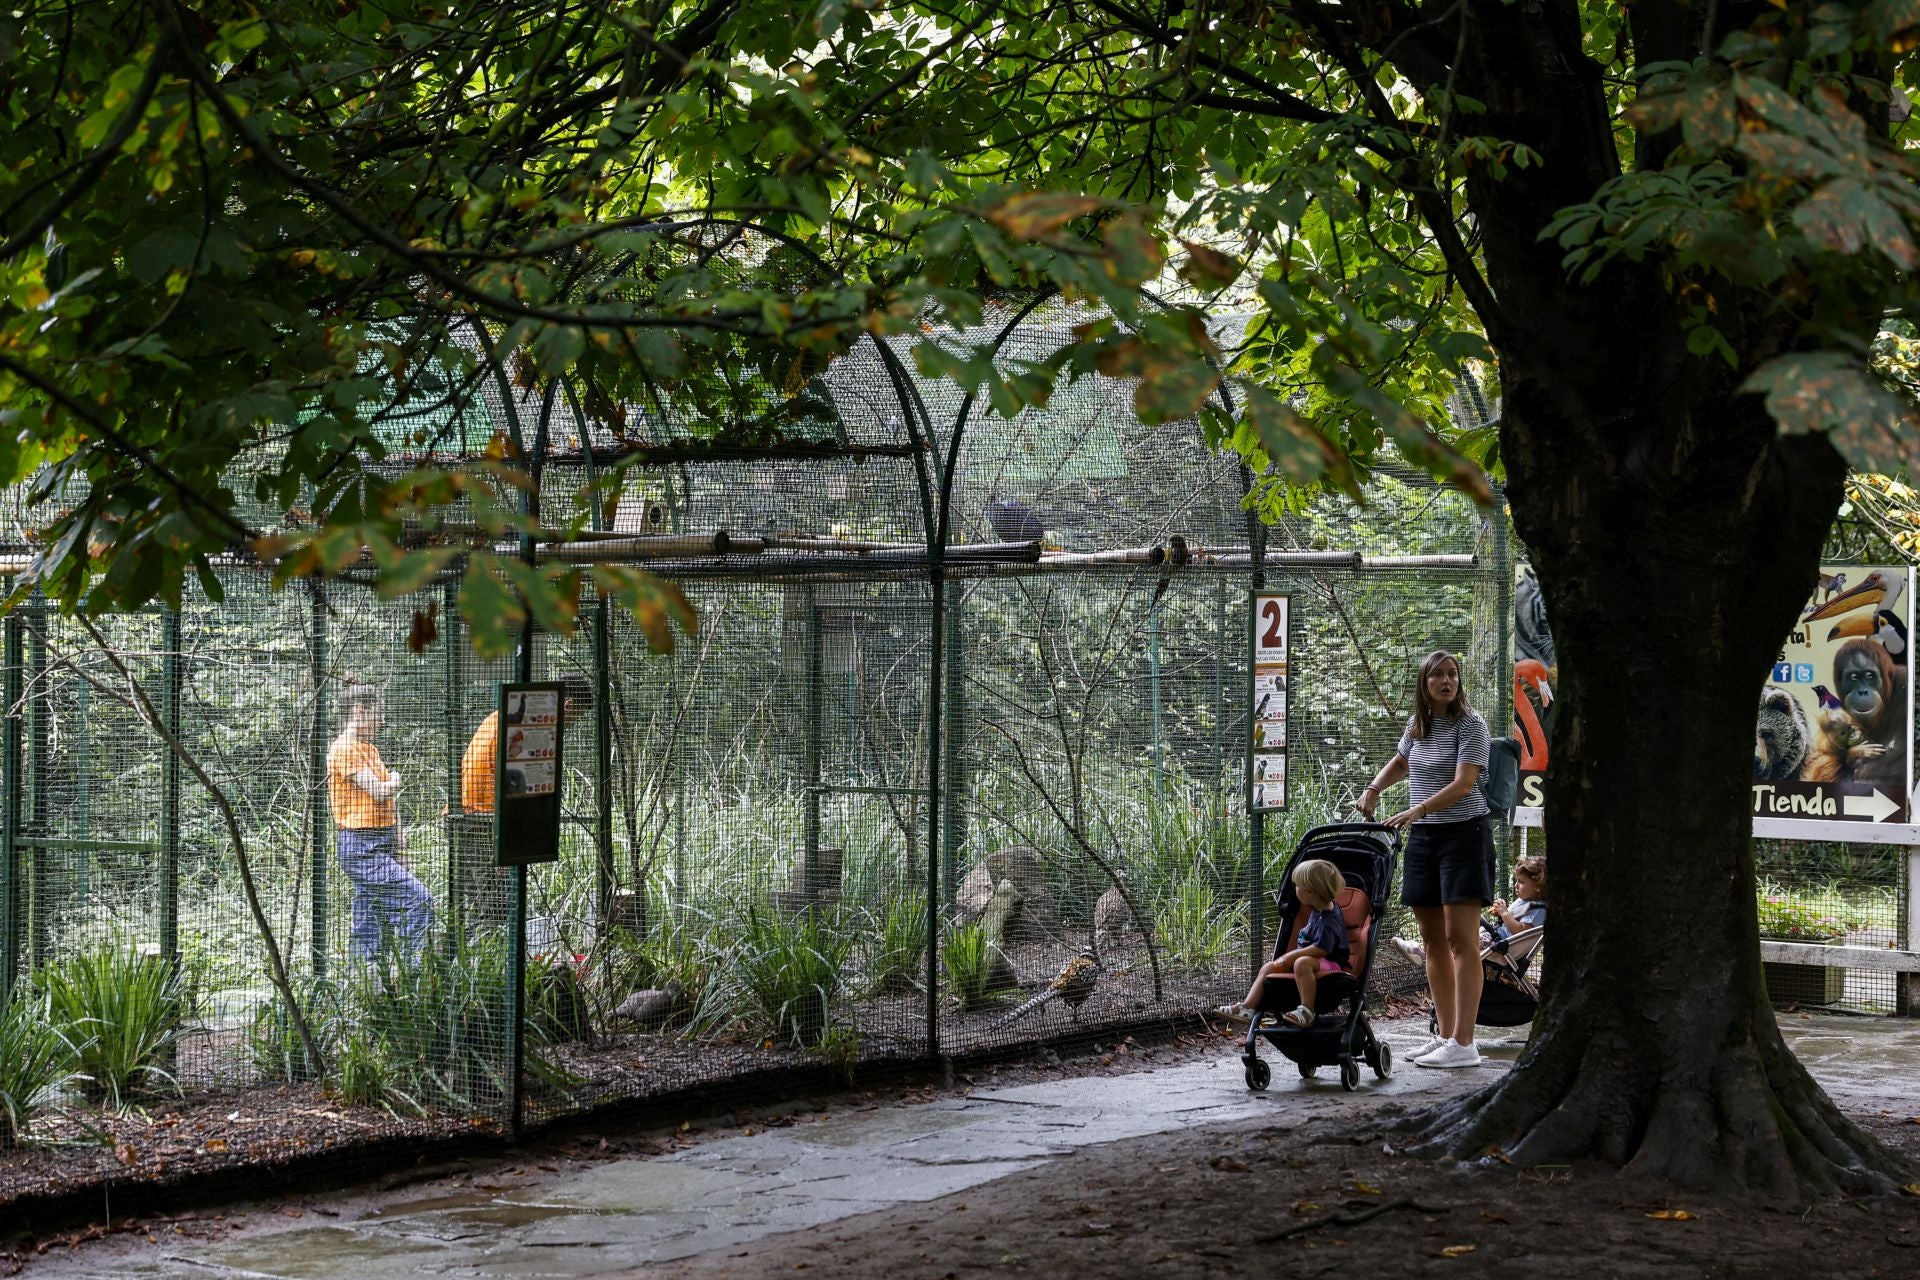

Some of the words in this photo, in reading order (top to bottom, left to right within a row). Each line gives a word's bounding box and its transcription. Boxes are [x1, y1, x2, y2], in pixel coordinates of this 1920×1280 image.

[1262, 600, 1282, 648] 2
[1786, 624, 1812, 648] ta!
[1523, 775, 1544, 807] S
[1752, 784, 1837, 816] Tienda
